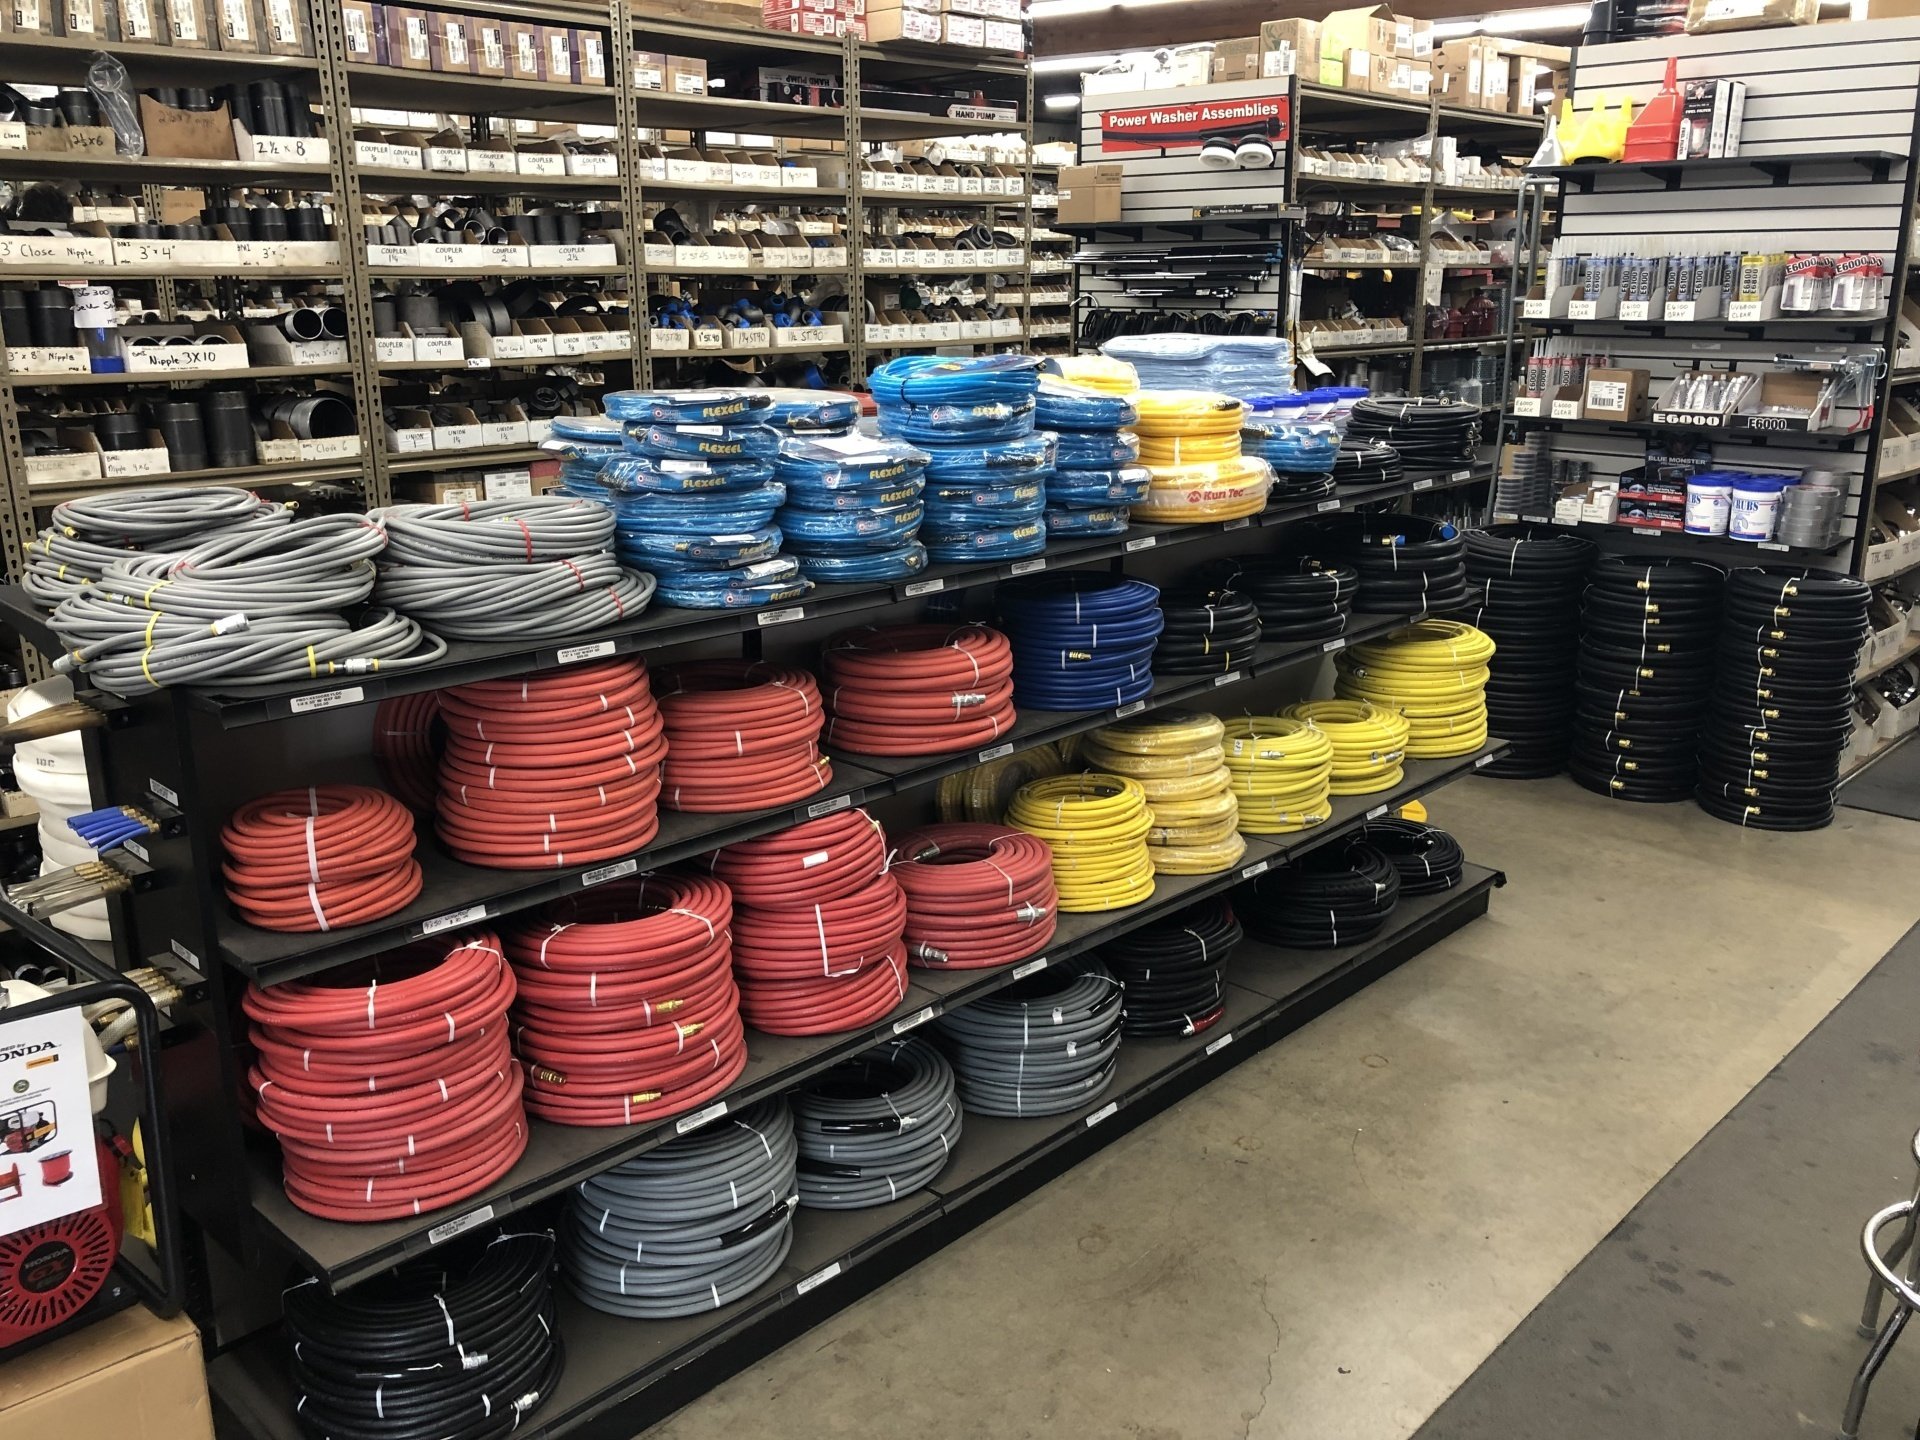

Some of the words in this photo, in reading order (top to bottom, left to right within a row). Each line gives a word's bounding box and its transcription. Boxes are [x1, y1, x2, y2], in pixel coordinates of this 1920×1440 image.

[955, 110, 975, 120] HAND
[976, 111, 996, 121] PUMP
[1109, 115, 1147, 127] Power
[1150, 110, 1198, 124] Washer
[1201, 103, 1278, 120] Assemblies
[296, 141, 306, 156] 8
[20, 243, 55, 257] Close
[66, 247, 94, 259] Nipple
[381, 247, 408, 255] COUPLER
[435, 247, 463, 255] COUPLER
[492, 247, 517, 255] COUPLER
[1785, 256, 1817, 274] E6000
[1835, 256, 1867, 274] E6000
[1585, 270, 1593, 293] E6100
[1593, 270, 1601, 293] E6100
[1630, 272, 1638, 294] E6100
[1640, 272, 1649, 295] E6100
[1680, 270, 1688, 294] E6100
[1695, 270, 1704, 293] E6100
[1723, 269, 1732, 293] E6100
[1742, 268, 1752, 294] E6800
[1750, 268, 1759, 294] E6800
[48, 352, 75, 363] Nipple
[149, 354, 180, 366] Nipple
[1529, 369, 1537, 392] E6000
[702, 402, 745, 418] FLEXEEL
[1652, 412, 1720, 426] E6000
[1748, 416, 1787, 430] E6000
[698, 442, 742, 454] FLEXEEL
[1648, 455, 1668, 463] BLUE
[1669, 457, 1706, 465] MONSTER
[869, 464, 905, 480] FLEXEEL
[683, 477, 727, 489] FLEXEEL
[881, 488, 915, 503] FLEXEEL
